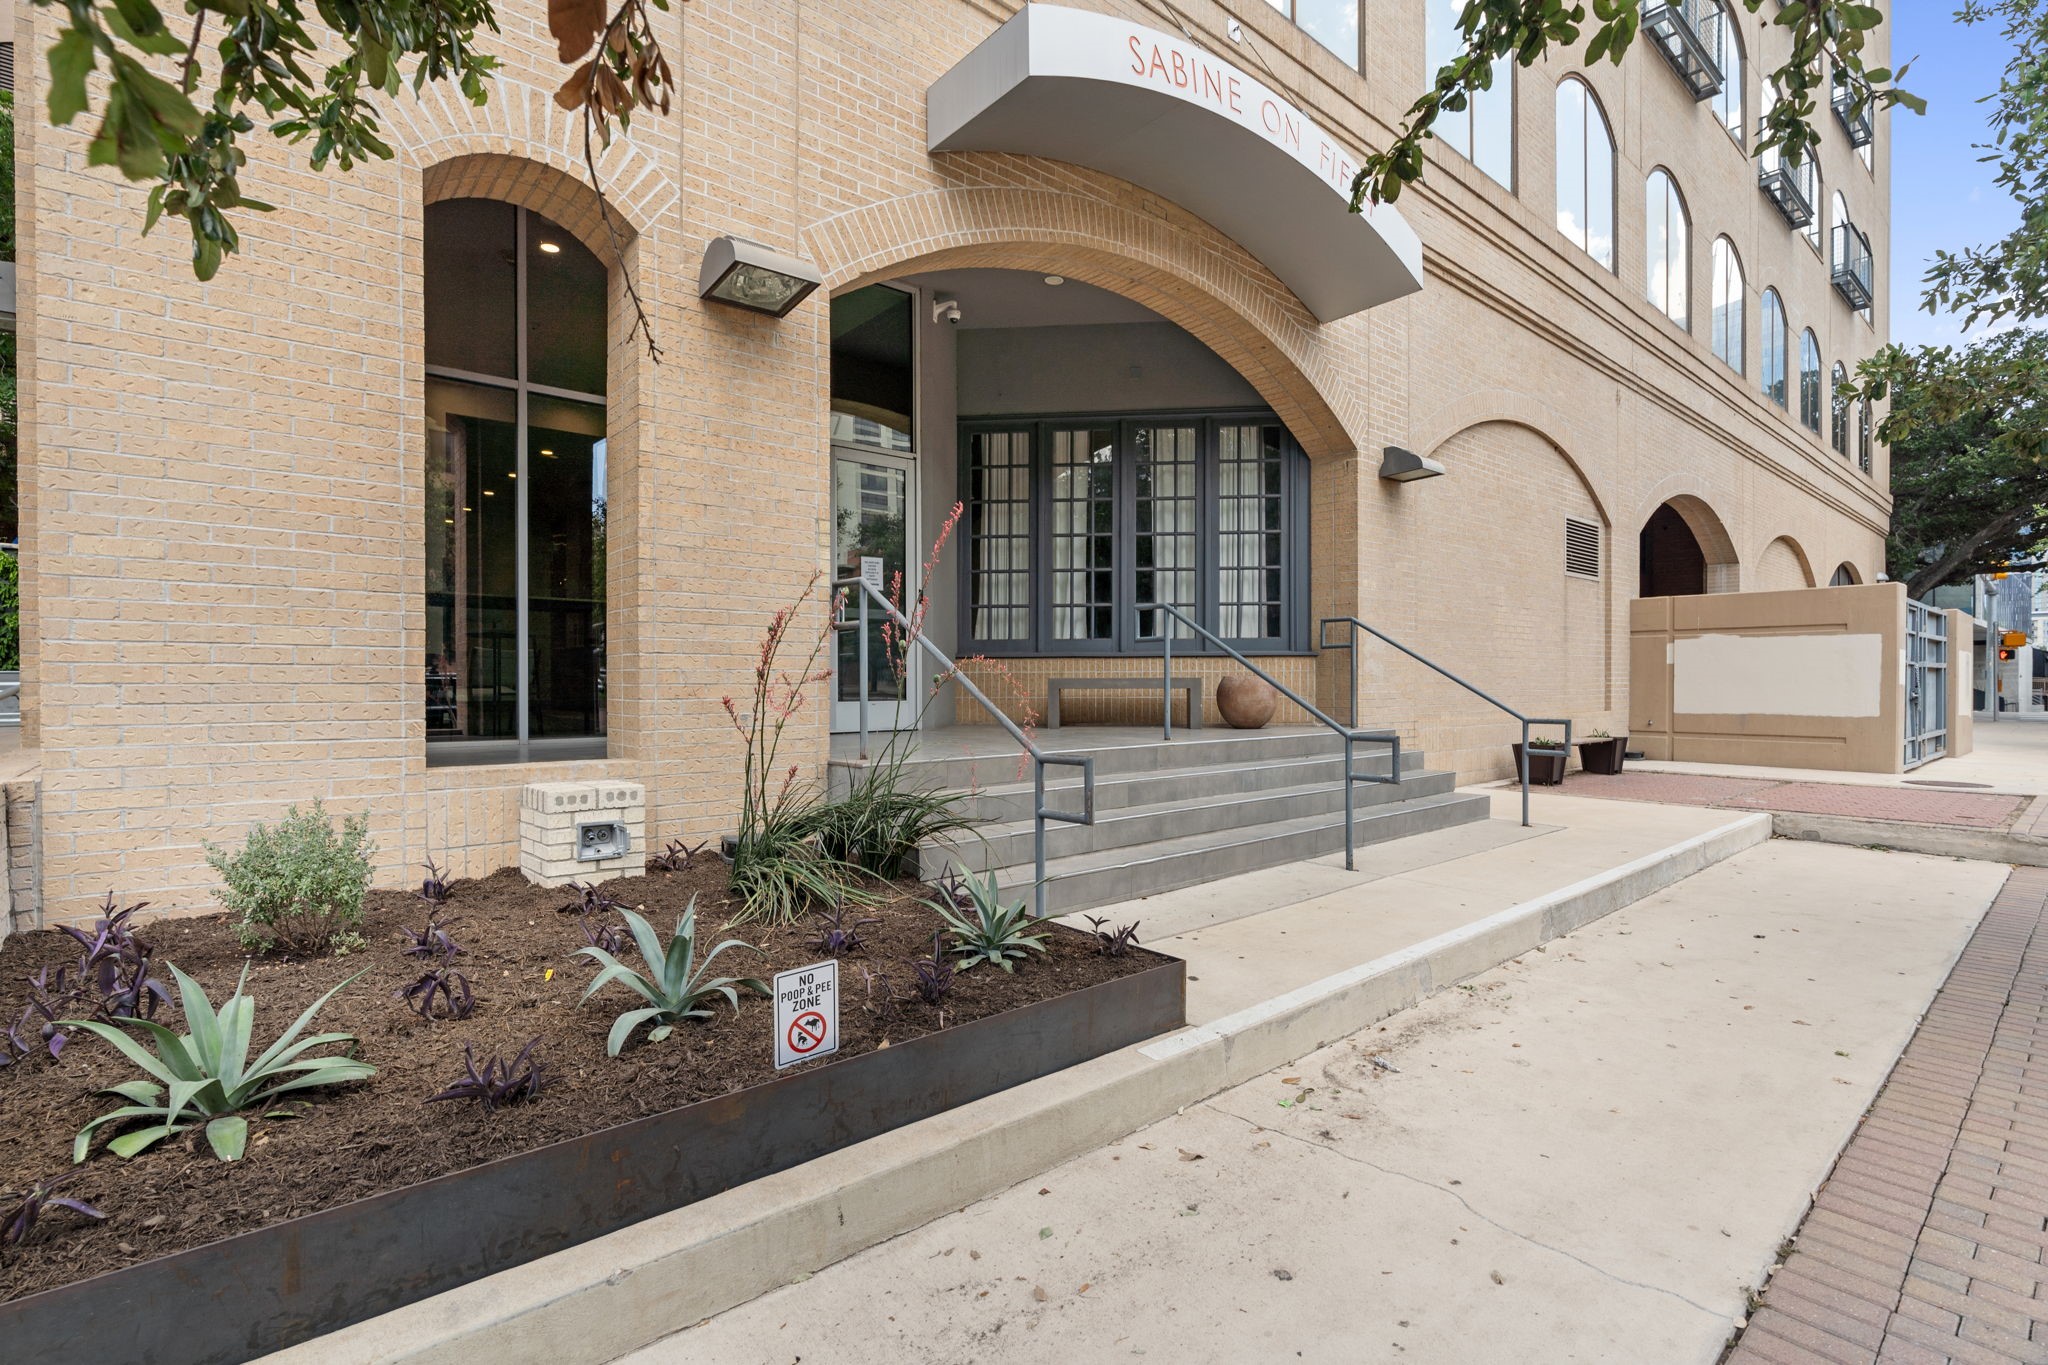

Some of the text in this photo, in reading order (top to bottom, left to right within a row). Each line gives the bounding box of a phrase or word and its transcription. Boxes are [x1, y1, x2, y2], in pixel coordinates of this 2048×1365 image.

[1128, 35, 1242, 115] SABINE
[1261, 100, 1300, 151] ON
[799, 973, 814, 986] NO
[780, 980, 831, 1003] POOP & PEE
[792, 994, 821, 1012] ZONE
